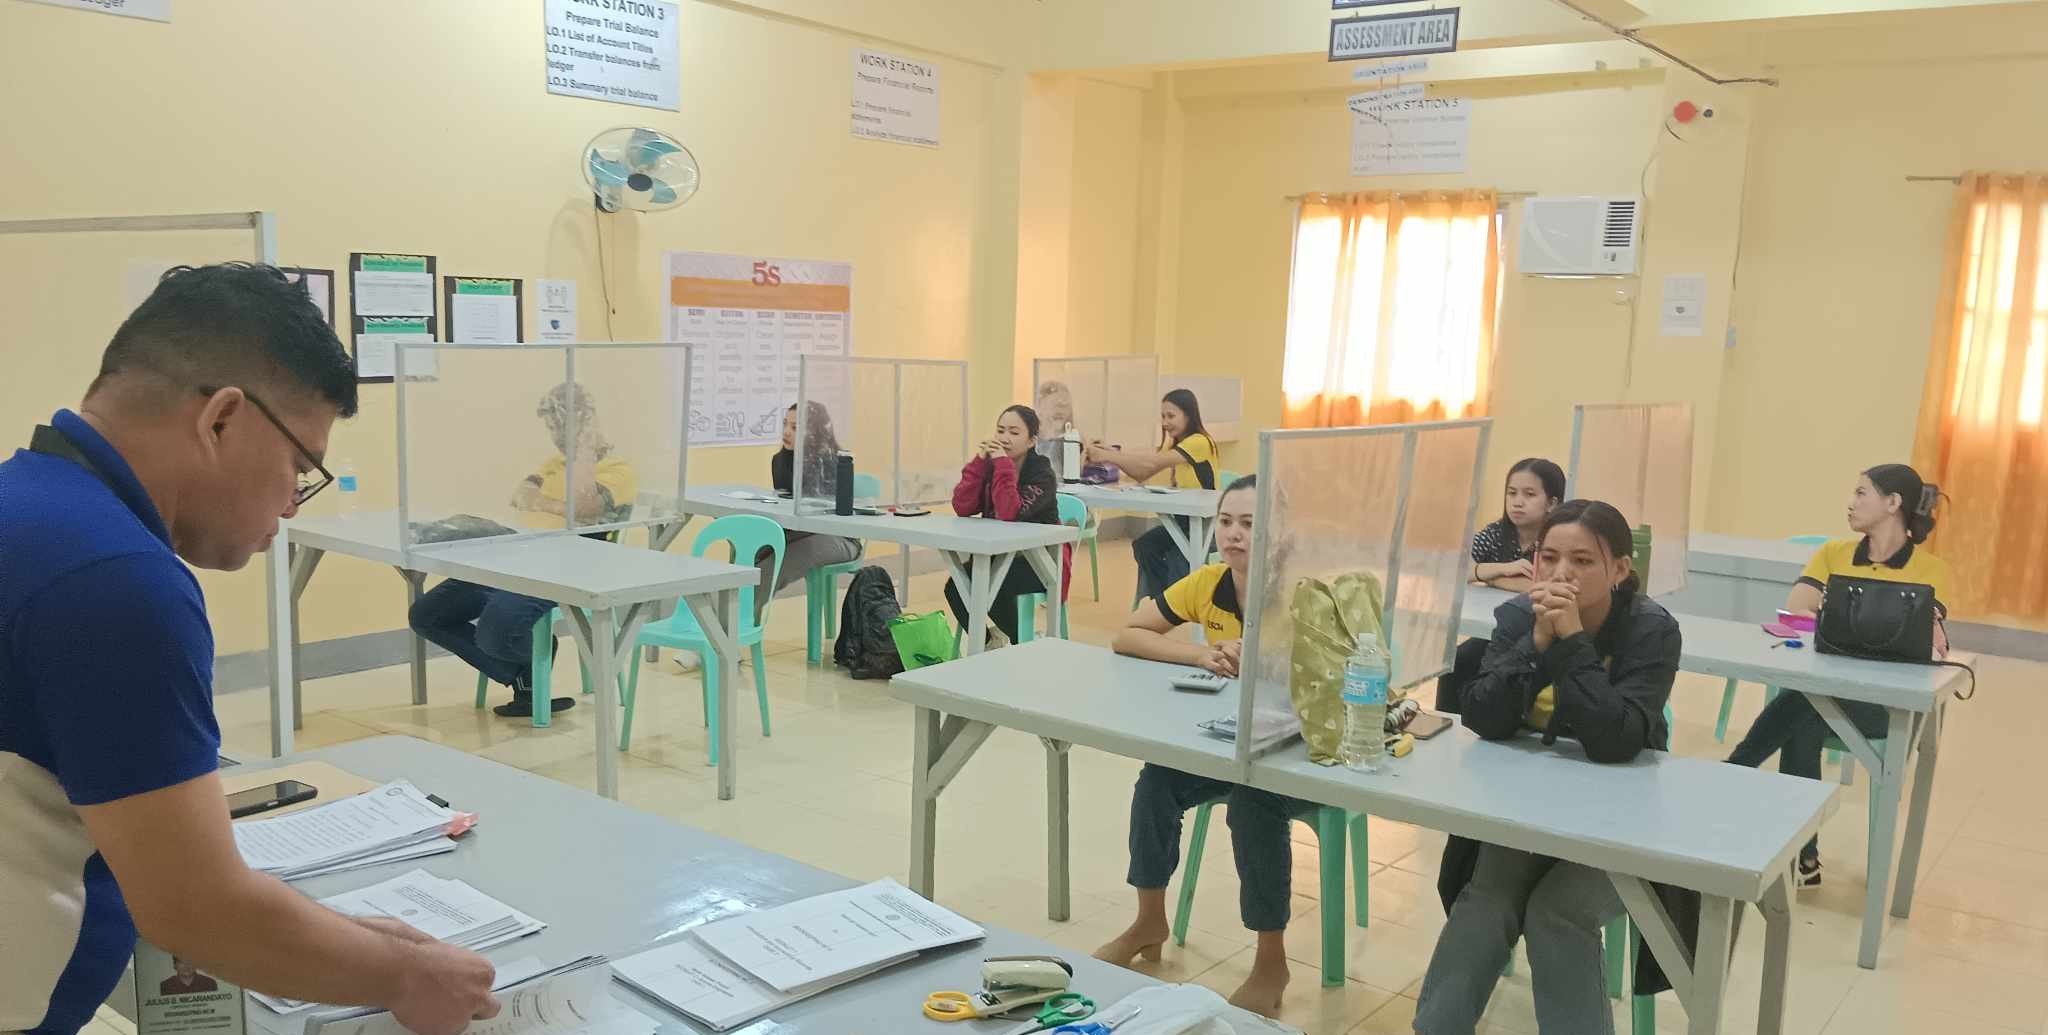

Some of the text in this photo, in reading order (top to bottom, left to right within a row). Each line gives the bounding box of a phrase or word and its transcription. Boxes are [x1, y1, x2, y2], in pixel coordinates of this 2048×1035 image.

[565, 11, 659, 38] Prepare Trial Balance
[657, 8, 665, 20] 3
[568, 29, 585, 41] List
[586, 33, 595, 43] of
[597, 36, 630, 50] Account
[632, 41, 654, 54] Titles
[1336, 18, 1451, 51] ASSESSMENT AREA
[546, 58, 575, 72] ledger
[568, 46, 604, 61] Transfer
[605, 53, 641, 68] balances
[860, 52, 888, 69] WORK
[889, 59, 925, 76] STATION
[569, 79, 609, 96] Summary
[610, 86, 626, 97] trial
[628, 87, 659, 102] balance
